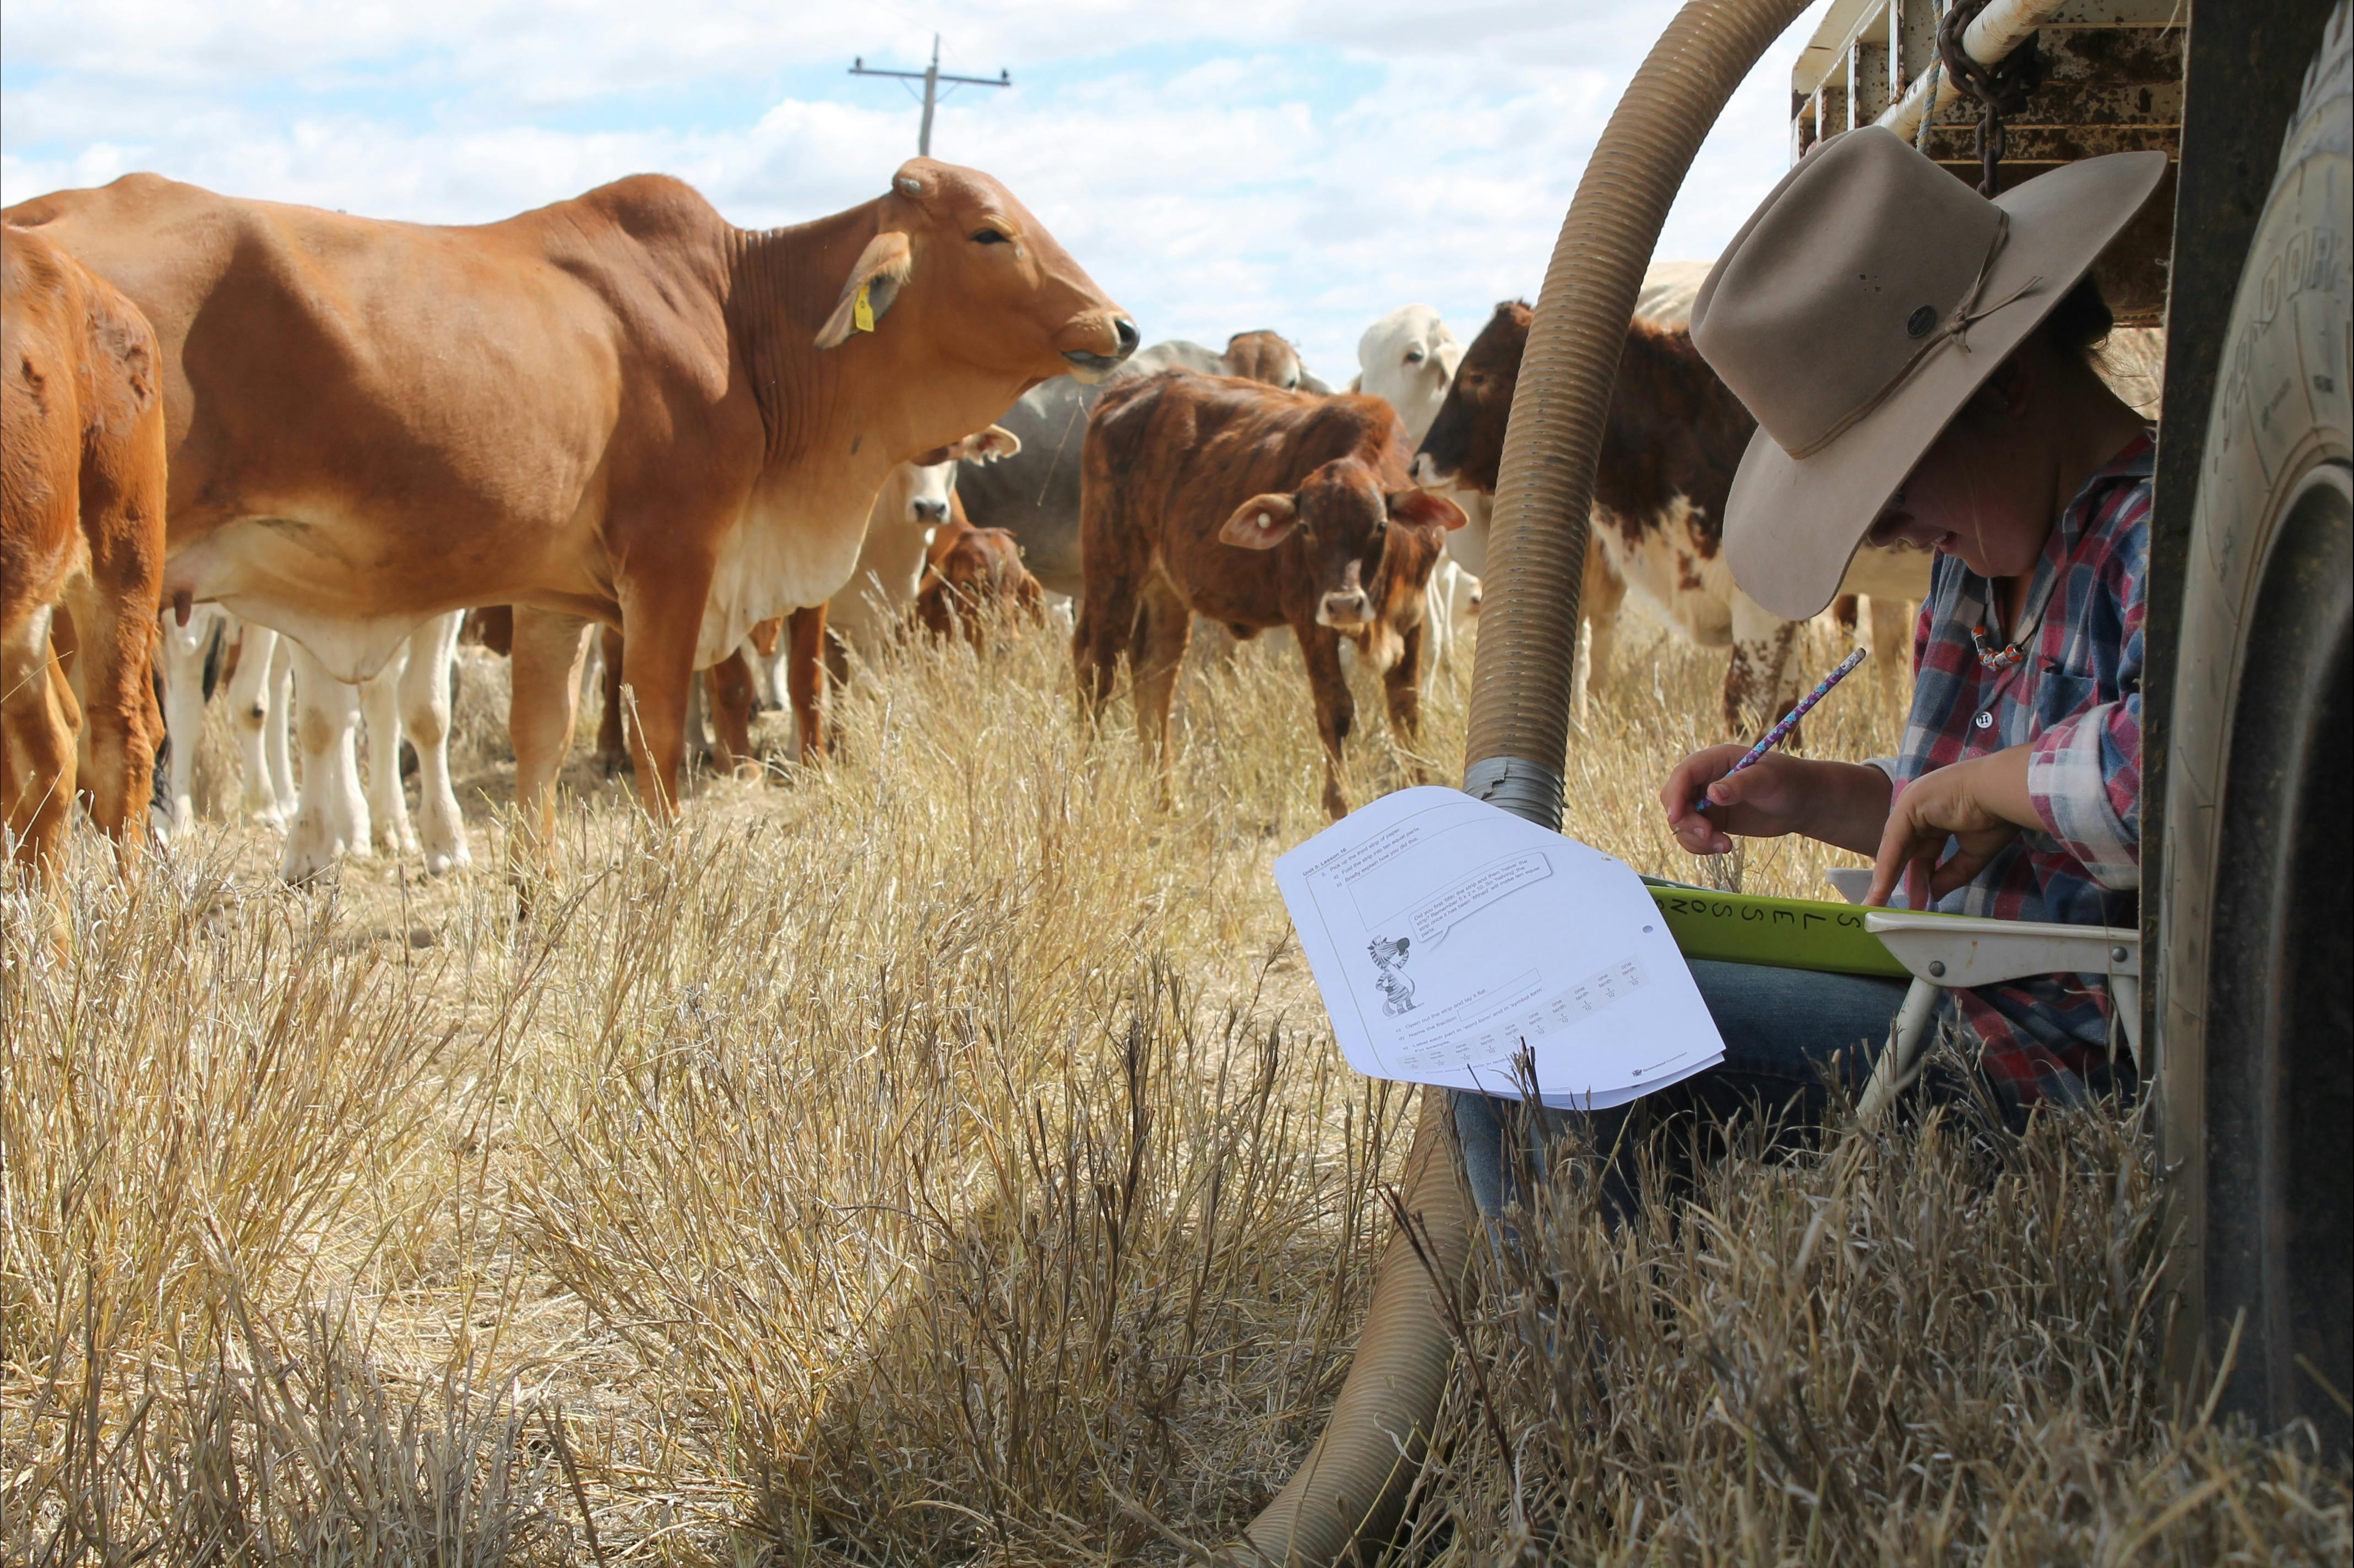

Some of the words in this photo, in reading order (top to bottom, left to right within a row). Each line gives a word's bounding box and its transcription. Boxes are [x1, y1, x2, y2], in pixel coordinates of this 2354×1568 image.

[1330, 863, 1341, 872] Pick
[1357, 846, 1368, 856] third
[1369, 840, 1379, 848] strip
[1385, 828, 1401, 840] paper.
[1341, 865, 1353, 875] Fold
[1362, 854, 1373, 863] strip
[1391, 834, 1406, 845] equal
[1303, 868, 1314, 876] Unit
[1320, 853, 1340, 866] Lesson
[1345, 871, 1360, 882] Briefly
[1361, 861, 1378, 873] explain
[1379, 853, 1389, 862] how
[1390, 848, 1399, 856] you
[1414, 912, 1423, 921] Did
[1423, 908, 1434, 916] you
[1433, 901, 1443, 910] first
[1465, 883, 1477, 891] strip
[1477, 876, 1487, 884] and
[1419, 923, 1430, 932] strip
[1431, 916, 1443, 925] once
[1457, 900, 1471, 908] been
[1499, 877, 1514, 886] make
[1417, 915, 1429, 926] strip?
[1431, 900, 1458, 918] Remember
[1599, 979, 1612, 988] tenth
[1622, 967, 1636, 976] tenth
[1575, 992, 1589, 1001] tenth
[1405, 1021, 1421, 1029] Open
[1454, 1000, 1464, 1008] and
[1463, 1021, 1477, 1030] 'word
[1478, 1014, 1491, 1023] form'
[1493, 1009, 1503, 1017] and
[1509, 994, 1530, 1007] 'symbol
[1529, 1017, 1543, 1025] tenth
[1552, 1004, 1566, 1014] tenth
[1409, 1030, 1426, 1038] Name
[1505, 1028, 1519, 1036] tenth
